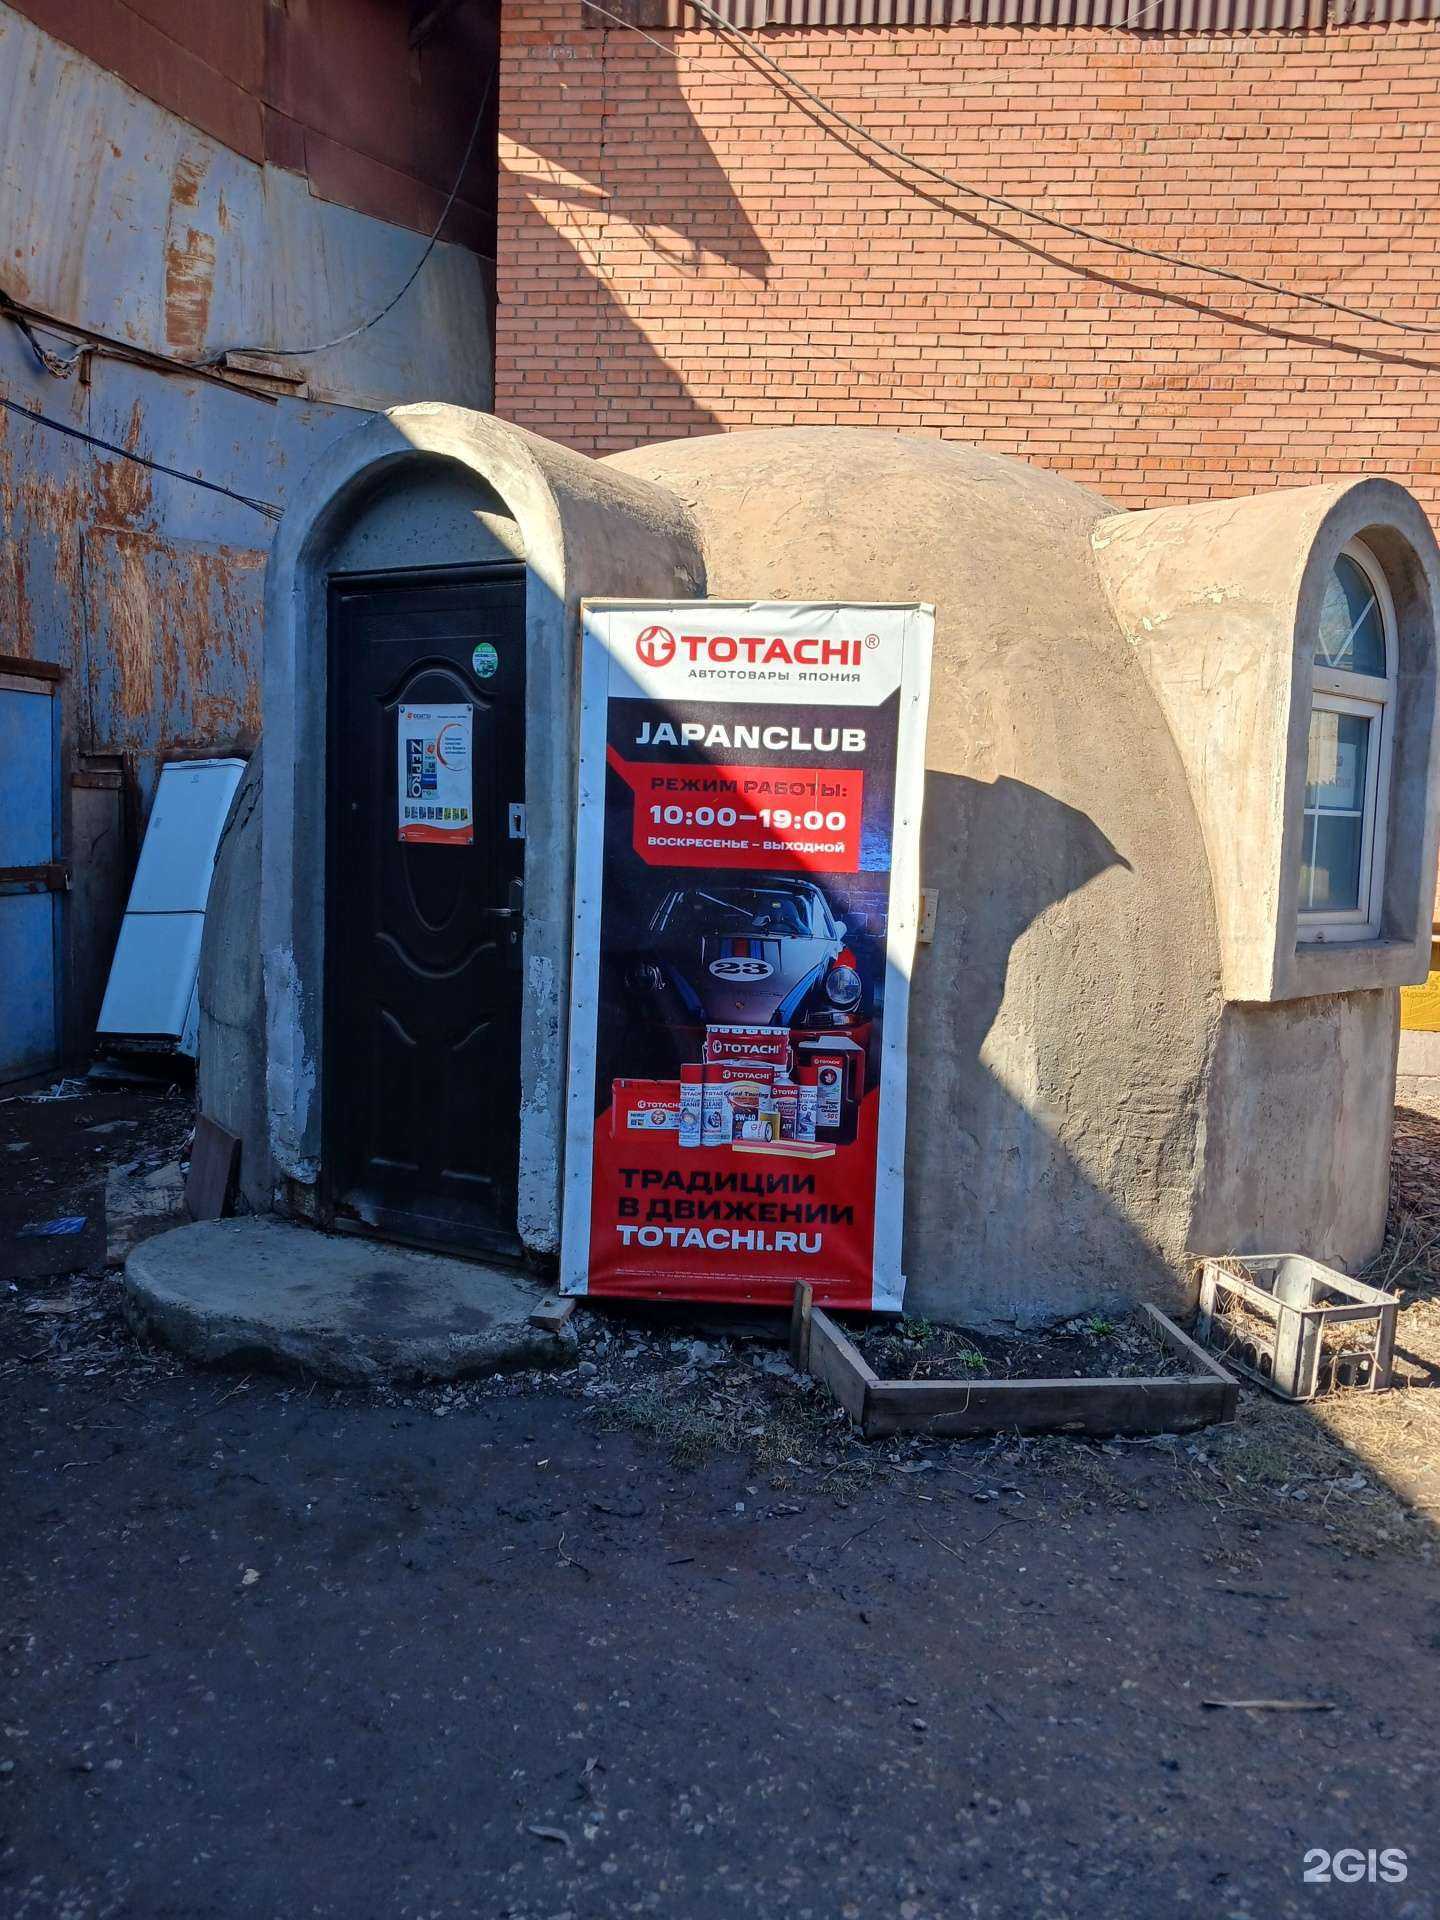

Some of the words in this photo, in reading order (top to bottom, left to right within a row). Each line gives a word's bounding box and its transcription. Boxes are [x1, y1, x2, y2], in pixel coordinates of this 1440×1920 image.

[688, 669, 790, 681] АВТОТОВАРЫ
[798, 672, 861, 683] ЯПОНИЯ
[636, 722, 866, 752] JAPANCLUB
[410, 740, 423, 798] ZEPRO
[651, 776, 737, 793] РЕЖИМ
[744, 780, 848, 798] РАБОТЫ:
[647, 836, 749, 849] ВОСКРЕСЕНЬЕ
[763, 839, 846, 854] ВЫХОДНОЙ
[714, 962, 768, 975] 23
[723, 1043, 779, 1055] TOTACHI
[732, 1071, 769, 1080] TOTACHI
[618, 1168, 816, 1197] ТРАДИЦИИ
[618, 1197, 640, 1217] В
[646, 1198, 855, 1225] ДВИЖЕНИИ
[616, 1224, 822, 1254] TOTACHI.RU
